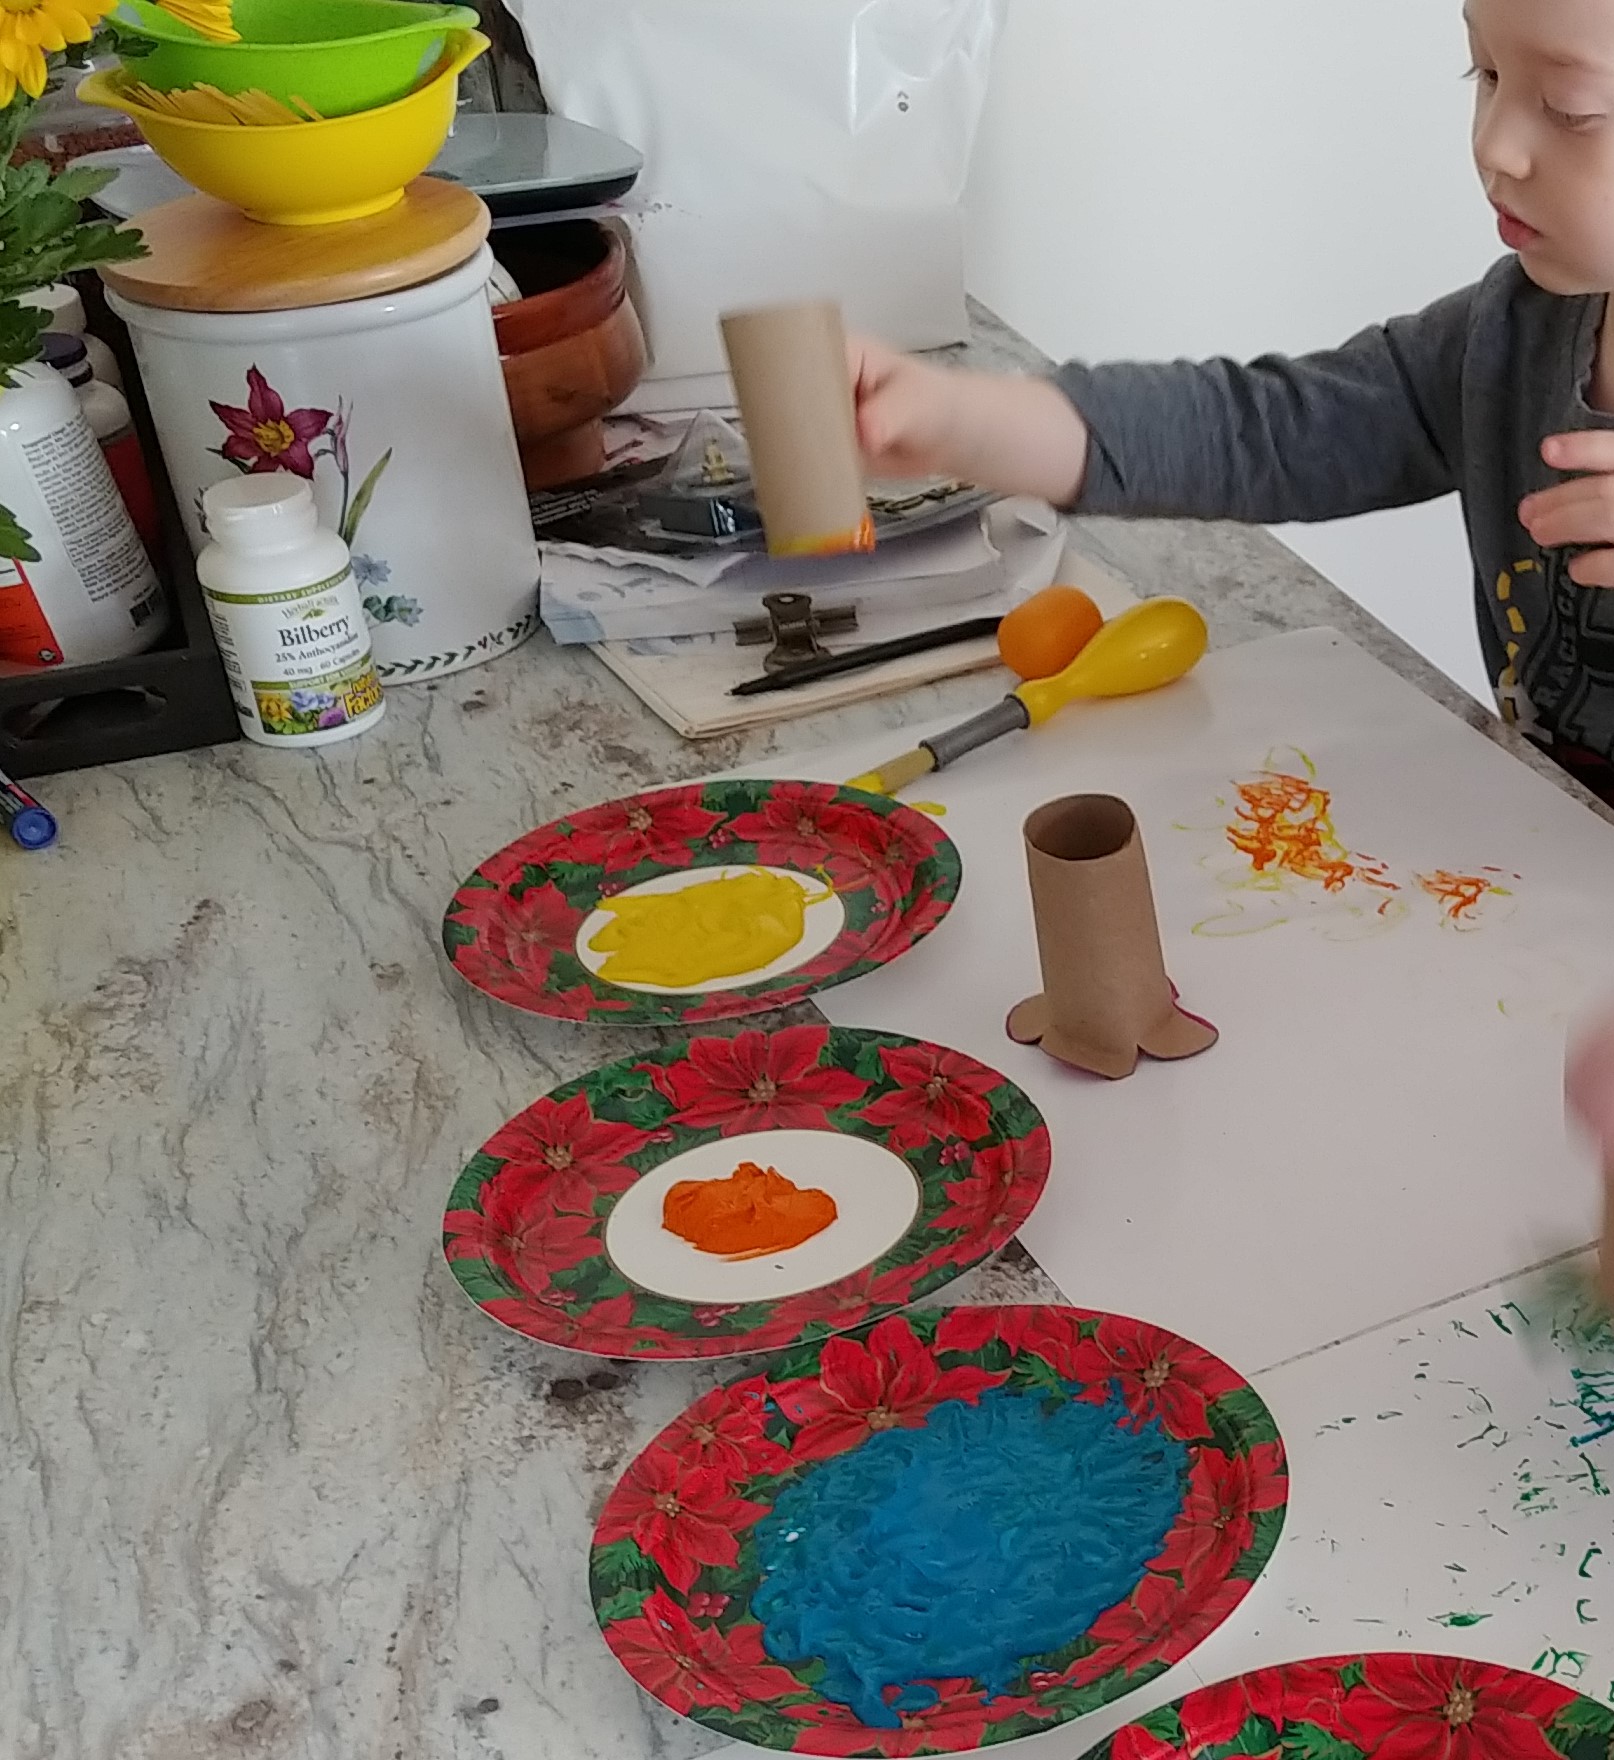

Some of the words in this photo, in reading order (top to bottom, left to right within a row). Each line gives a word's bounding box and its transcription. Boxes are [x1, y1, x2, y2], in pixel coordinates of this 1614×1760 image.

[277, 616, 349, 647] Bilberry
[275, 652, 296, 663] 25%
[283, 668, 296, 677] 40
[296, 666, 313, 676] mg
